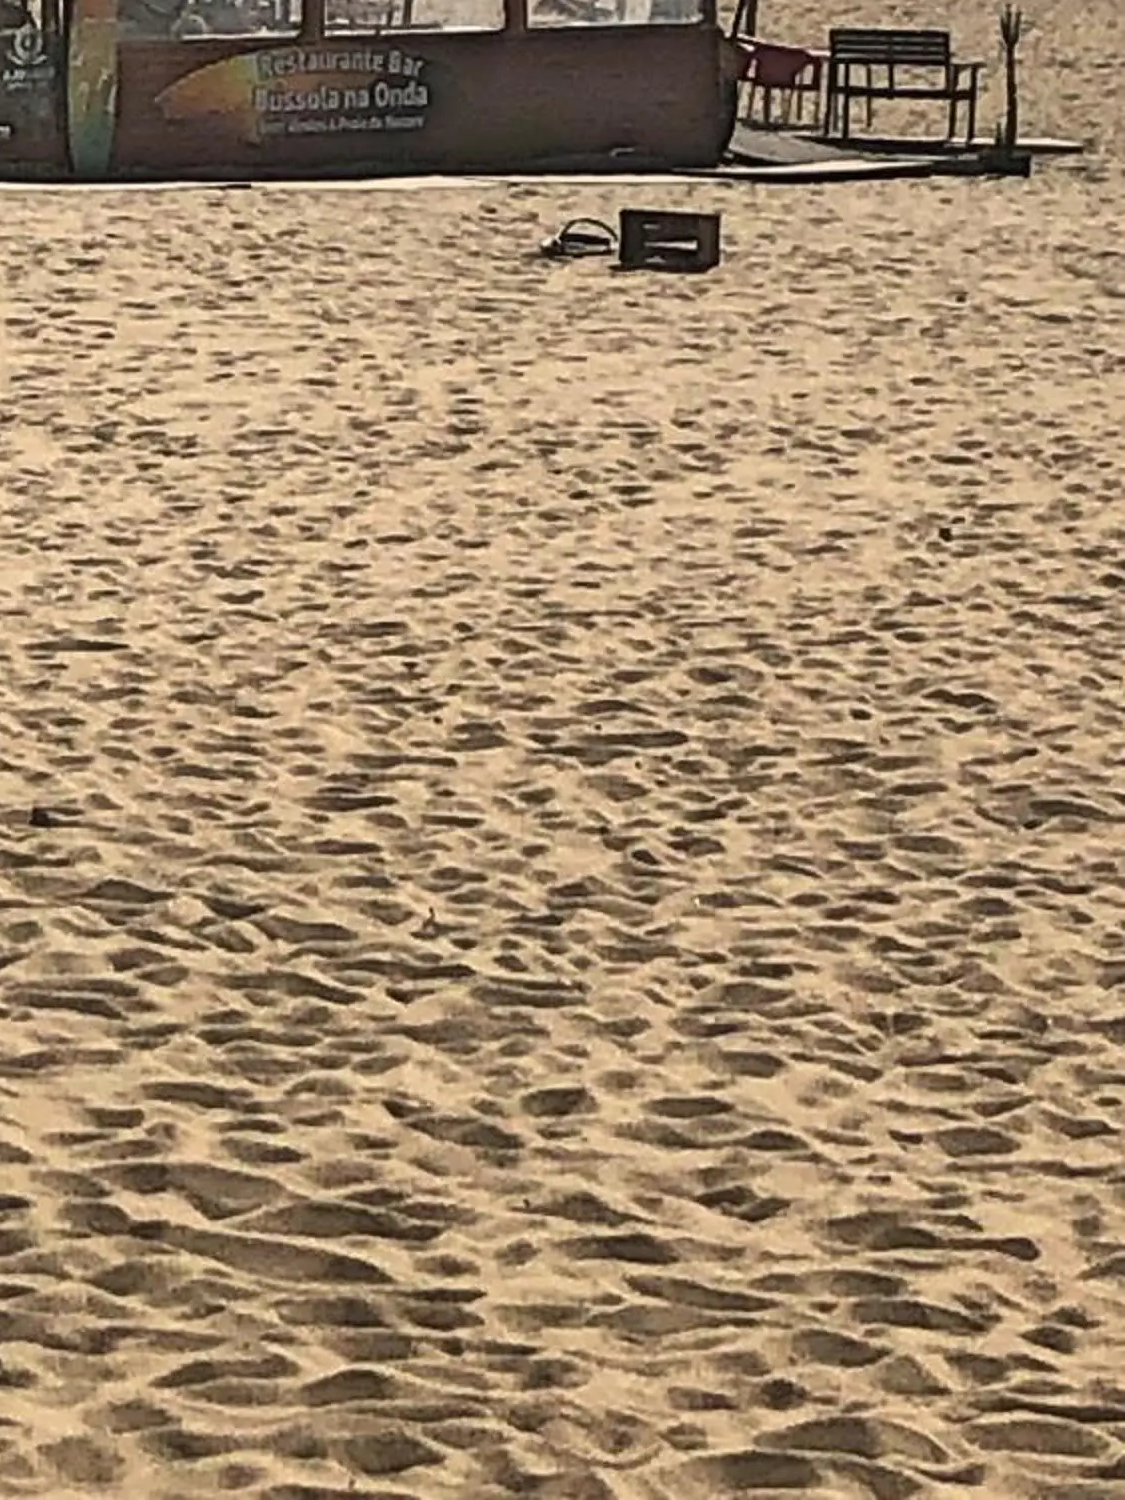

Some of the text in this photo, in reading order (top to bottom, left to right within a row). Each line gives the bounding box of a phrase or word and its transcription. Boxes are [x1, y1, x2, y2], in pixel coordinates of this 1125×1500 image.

[261, 50, 423, 77] Restaurante Bar
[344, 89, 370, 110] na
[375, 80, 428, 108] Onda
